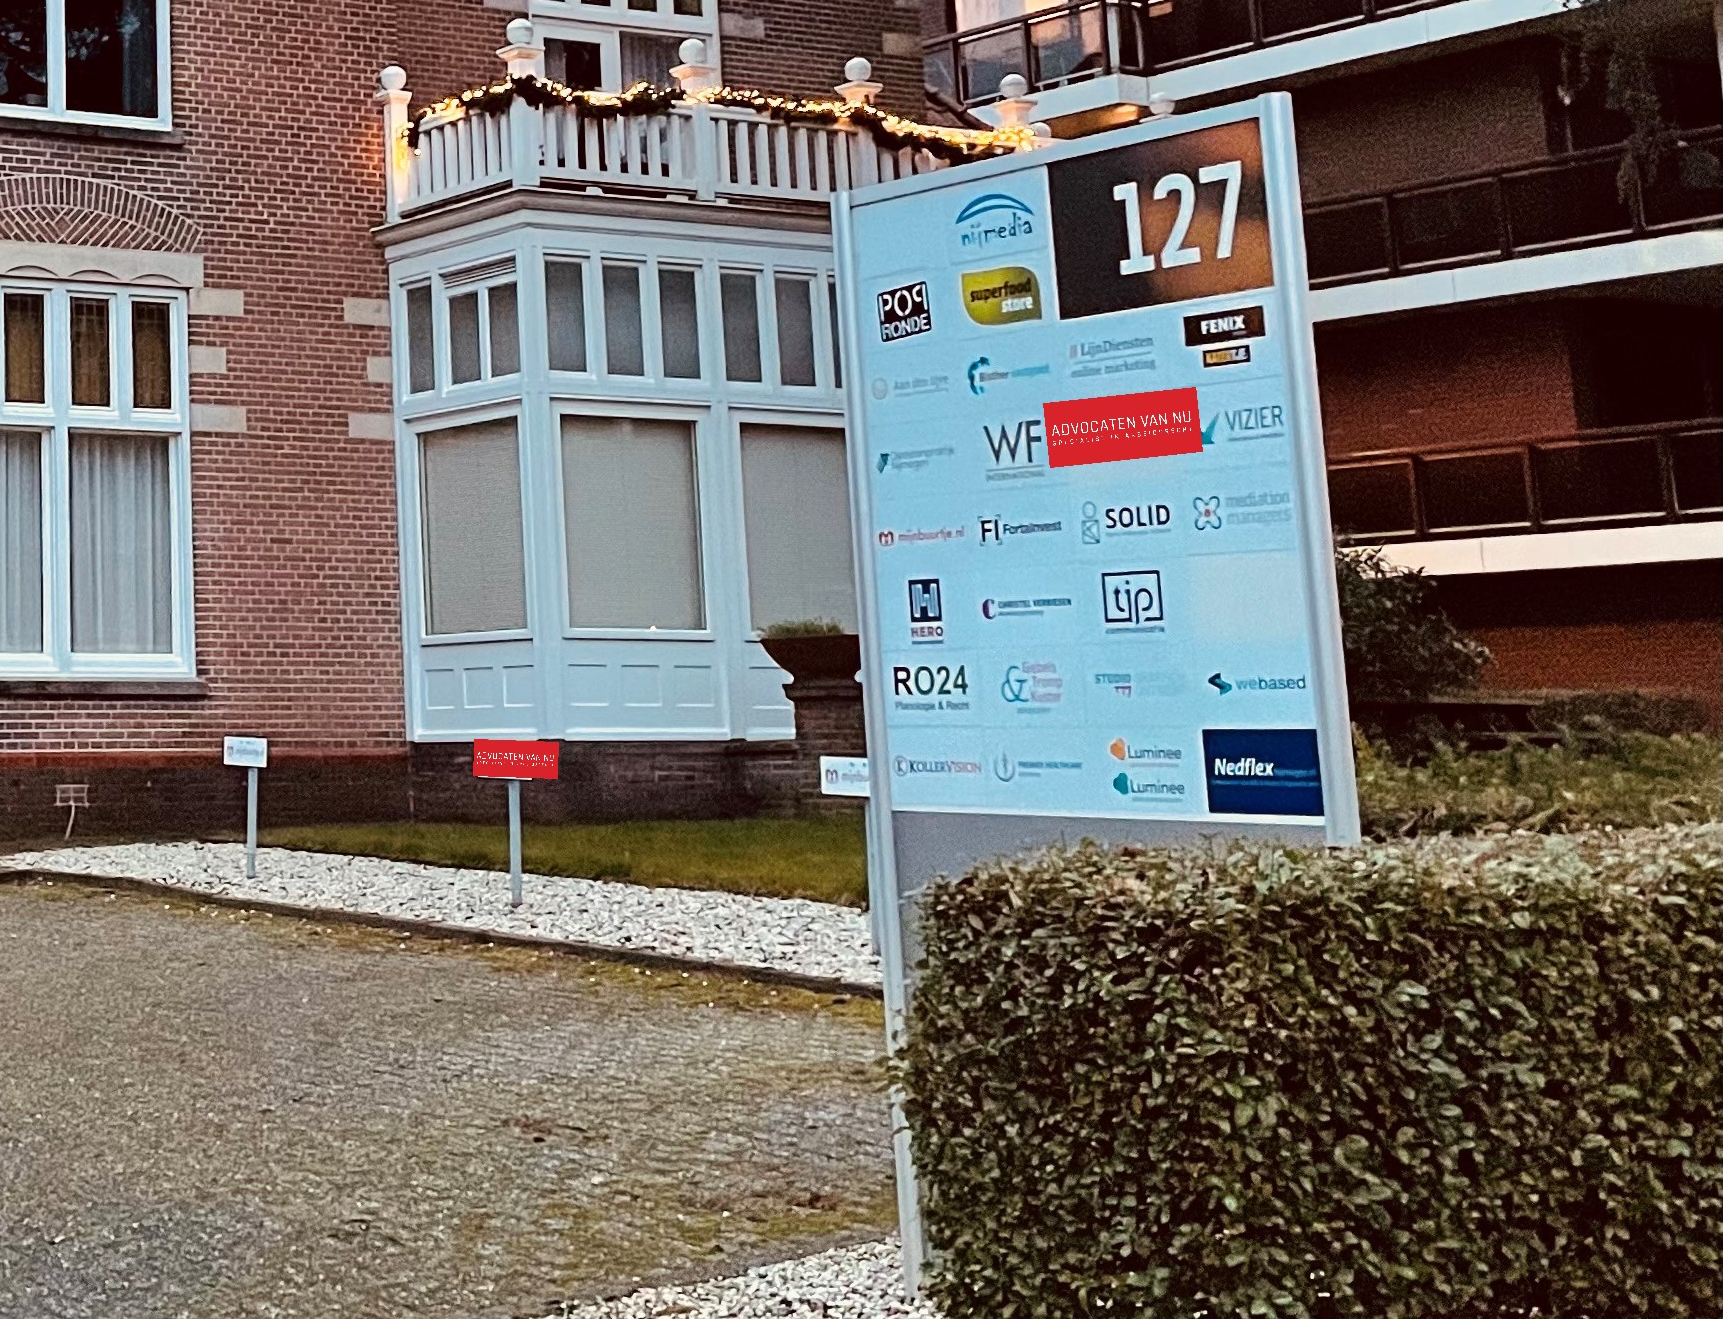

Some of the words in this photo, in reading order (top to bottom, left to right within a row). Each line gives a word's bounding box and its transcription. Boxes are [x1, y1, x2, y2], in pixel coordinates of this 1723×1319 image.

[960, 212, 1033, 248] nijmedia
[1113, 160, 1242, 276] 127
[970, 278, 1033, 303] superfood
[1001, 297, 1033, 312] store
[881, 313, 931, 340] RONDE
[1200, 315, 1246, 335] FENIX
[1051, 416, 1136, 437] ADVOCATEN
[1140, 412, 1167, 428] VAN
[1172, 410, 1192, 424] NU
[1224, 405, 1284, 431] VIZIER
[983, 419, 1042, 465] WF
[1105, 504, 1171, 529] SOLID
[910, 626, 944, 638] HERO
[892, 664, 969, 696] RO24
[1234, 675, 1307, 691] webased
[1127, 745, 1182, 760] Luminee
[909, 759, 982, 774] KOLLERVISION
[1214, 757, 1274, 777] Nedflex
[1130, 780, 1185, 796] Luminee
